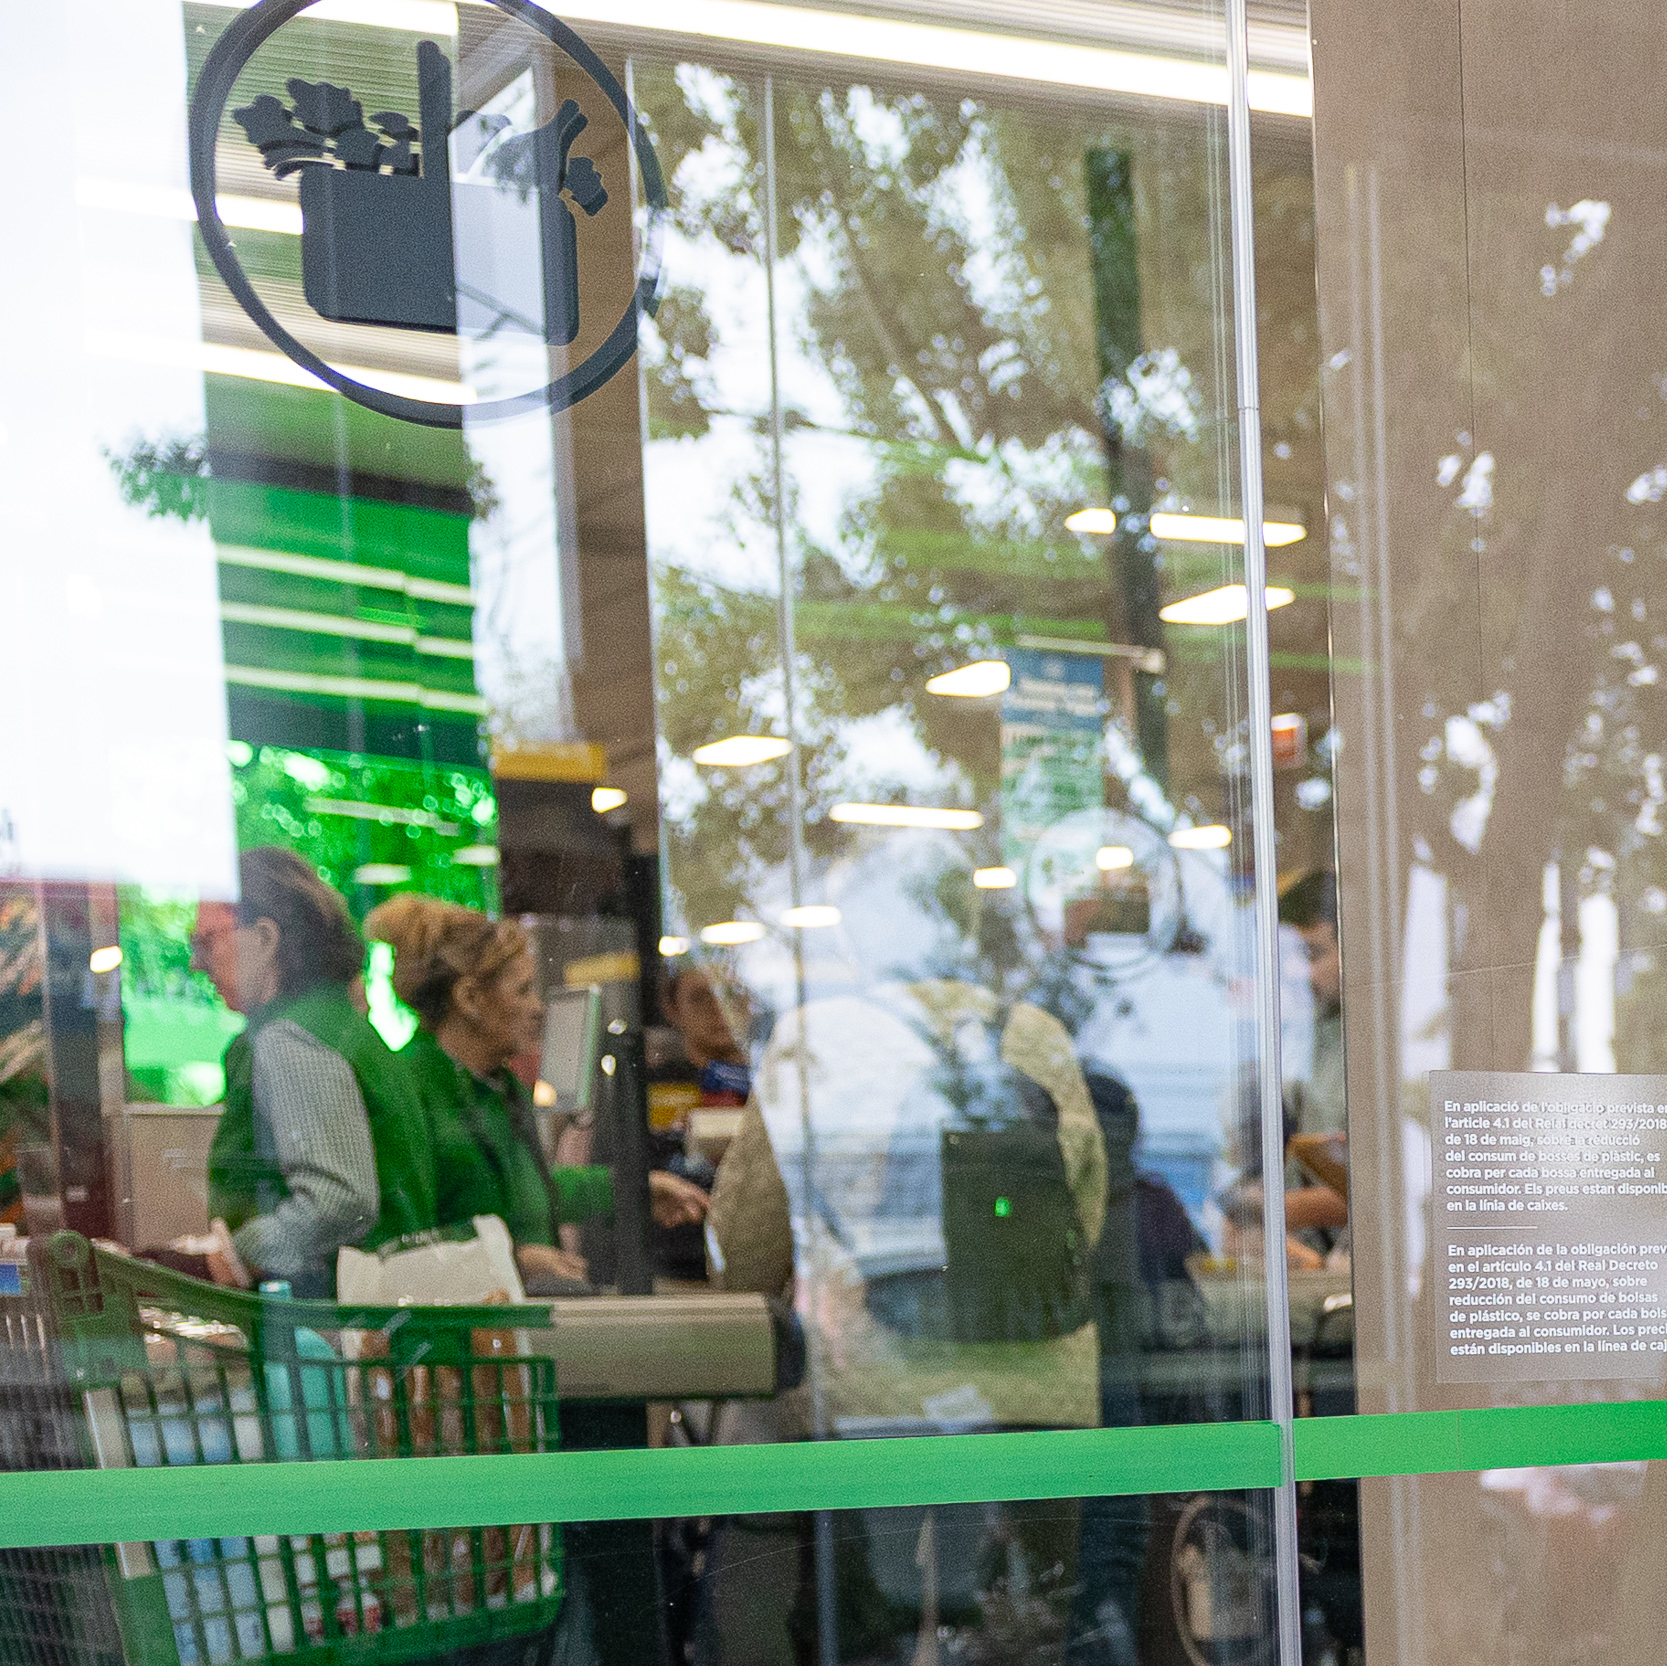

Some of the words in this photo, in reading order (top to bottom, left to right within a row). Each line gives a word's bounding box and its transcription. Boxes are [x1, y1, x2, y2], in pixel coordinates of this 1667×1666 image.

[1445, 1101, 1460, 1112] En
[1464, 1101, 1519, 1114] aplicació
[1522, 1102, 1538, 1112] de
[1608, 1103, 1654, 1114] prevista
[1445, 1118, 1490, 1129] l'article
[1493, 1118, 1509, 1129] 4.1
[1513, 1118, 1533, 1129] del
[1445, 1134, 1461, 1146] de
[1464, 1134, 1477, 1145] 18
[1480, 1135, 1497, 1146] de
[1574, 1135, 1585, 1146] la
[1446, 1151, 1465, 1162] del
[1468, 1153, 1516, 1162] consum
[1519, 1151, 1535, 1162] de
[1539, 1151, 1580, 1162] bosses
[1583, 1151, 1599, 1162] de
[1647, 1153, 1660, 1162] es
[1446, 1168, 1481, 1178] cobra
[1485, 1170, 1506, 1179] per
[1509, 1168, 1538, 1178] cada
[1541, 1168, 1578, 1178] bossa
[1580, 1168, 1641, 1179] entregada
[1644, 1167, 1654, 1178] al
[1446, 1184, 1521, 1195] consumidor.
[1525, 1184, 1543, 1195] Els
[1546, 1186, 1579, 1195] preus
[1582, 1185, 1615, 1194] estan
[1447, 1203, 1462, 1211] en
[1466, 1201, 1476, 1211] la
[1480, 1201, 1505, 1211] línia
[1508, 1200, 1524, 1211] de
[1527, 1200, 1567, 1211] caixes.
[1449, 1246, 1465, 1256] En
[1468, 1245, 1533, 1257] aplicación
[1537, 1244, 1553, 1255] de
[1556, 1244, 1568, 1255] la
[1571, 1244, 1636, 1255] obligación
[1449, 1264, 1464, 1272] en
[1468, 1261, 1480, 1272] el
[1483, 1261, 1532, 1272] artículo
[1535, 1261, 1551, 1271] 4.1
[1555, 1261, 1575, 1271] del
[1579, 1260, 1606, 1271] Real
[1609, 1260, 1658, 1271] Decreto
[1449, 1278, 1513, 1291] 293/2018,
[1516, 1277, 1532, 1288] de
[1536, 1277, 1549, 1288] 18
[1552, 1277, 1568, 1288] de
[1572, 1279, 1609, 1289] mayo,
[1449, 1294, 1512, 1305] reducción
[1516, 1294, 1536, 1305] del
[1539, 1295, 1596, 1304] consumo
[1599, 1293, 1616, 1304] de
[1619, 1292, 1658, 1303] bolsas
[1450, 1311, 1466, 1322] de
[1469, 1310, 1523, 1324] plástico,
[1526, 1313, 1541, 1322] se
[1544, 1310, 1579, 1321] cobra
[1583, 1311, 1605, 1321] por
[1608, 1309, 1637, 1320] cada
[1450, 1327, 1515, 1339] entregada
[1519, 1326, 1530, 1338] al
[1533, 1326, 1609, 1338] consumidor.
[1613, 1325, 1635, 1336] Los
[1450, 1344, 1485, 1355] están
[1488, 1343, 1561, 1355] disponibles
[1564, 1345, 1580, 1353] en
[1584, 1342, 1594, 1353] la
[1598, 1341, 1628, 1352] línea
[1631, 1341, 1647, 1352] de
